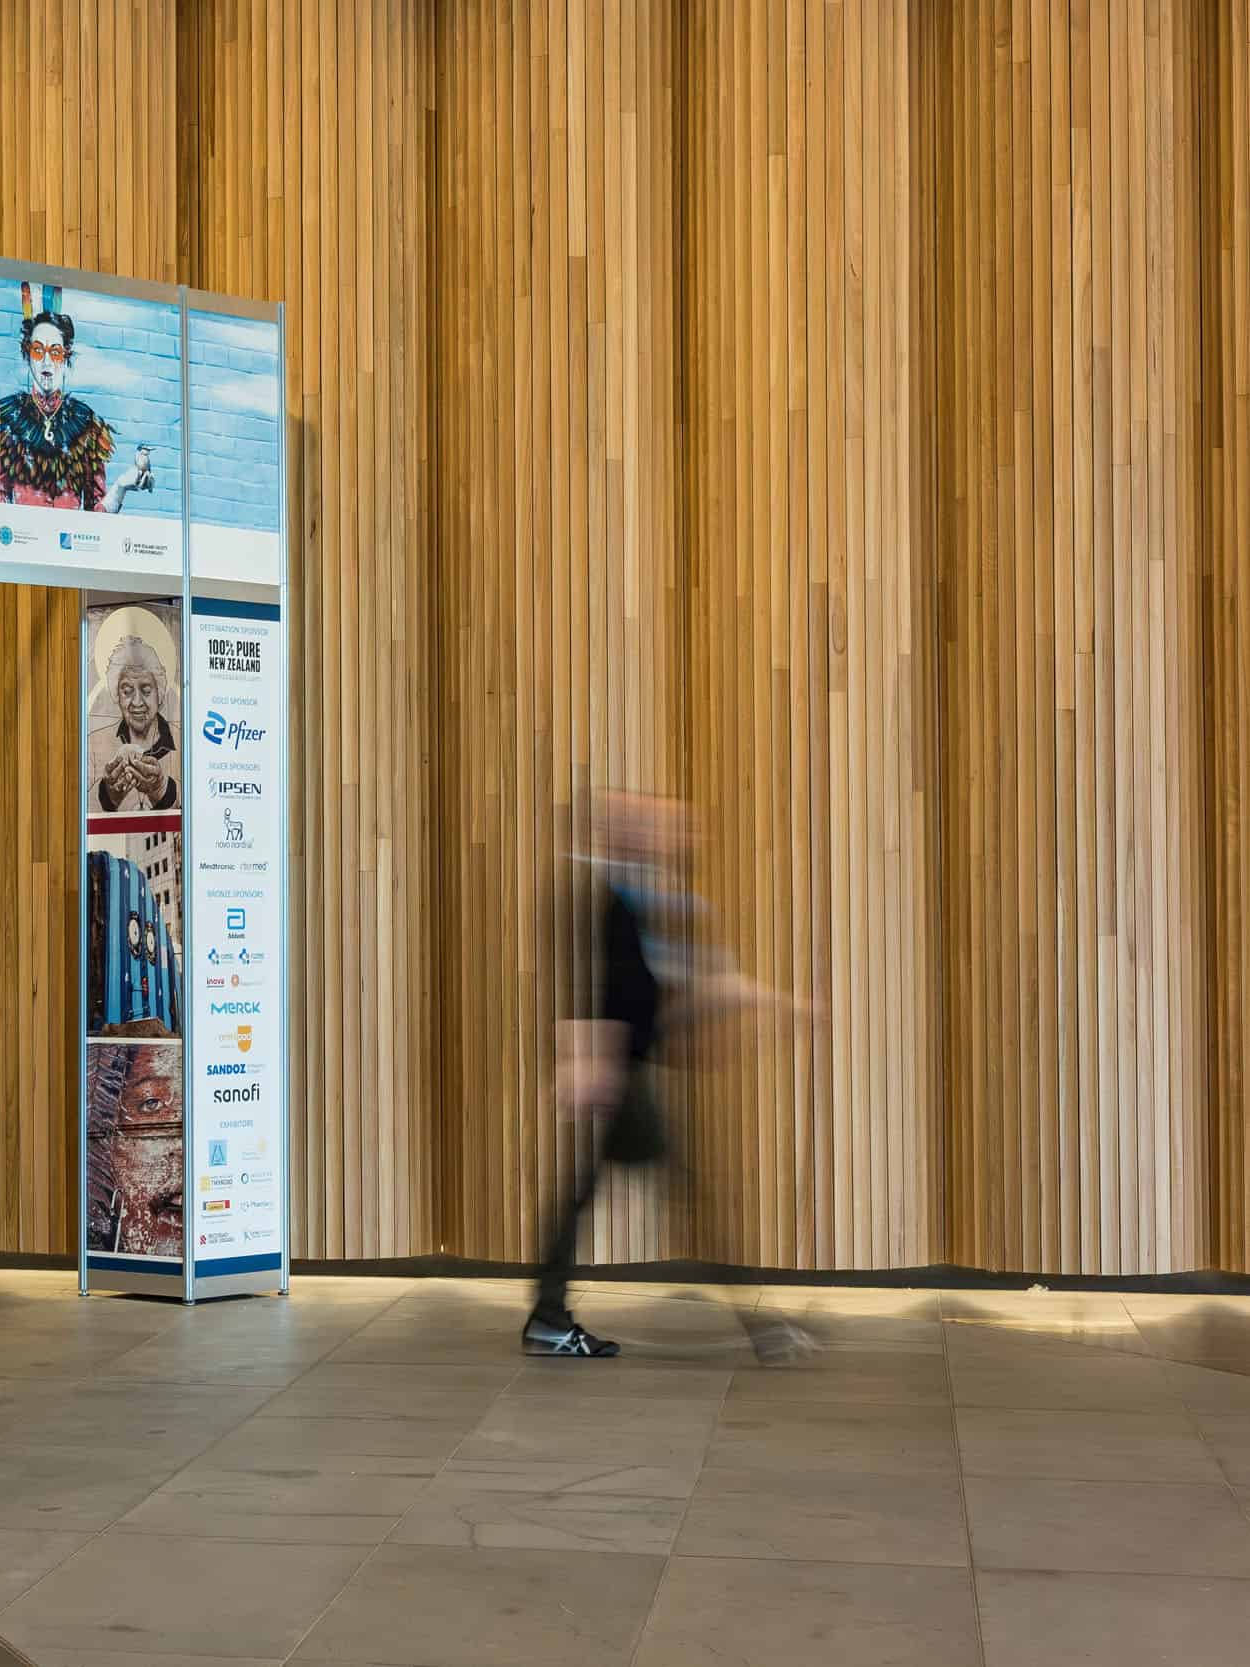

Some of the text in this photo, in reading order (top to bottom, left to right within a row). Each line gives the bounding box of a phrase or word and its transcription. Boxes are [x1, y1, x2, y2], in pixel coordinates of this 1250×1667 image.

[208, 639, 261, 658] 100% PURE
[209, 656, 261, 673] NEW ZEALAND
[228, 719, 267, 751] Pfizer
[218, 782, 262, 795] IPSEN
[210, 1001, 261, 1015] MERCK
[206, 1063, 247, 1076] SANDOZ
[213, 1083, 261, 1104] sanofi
